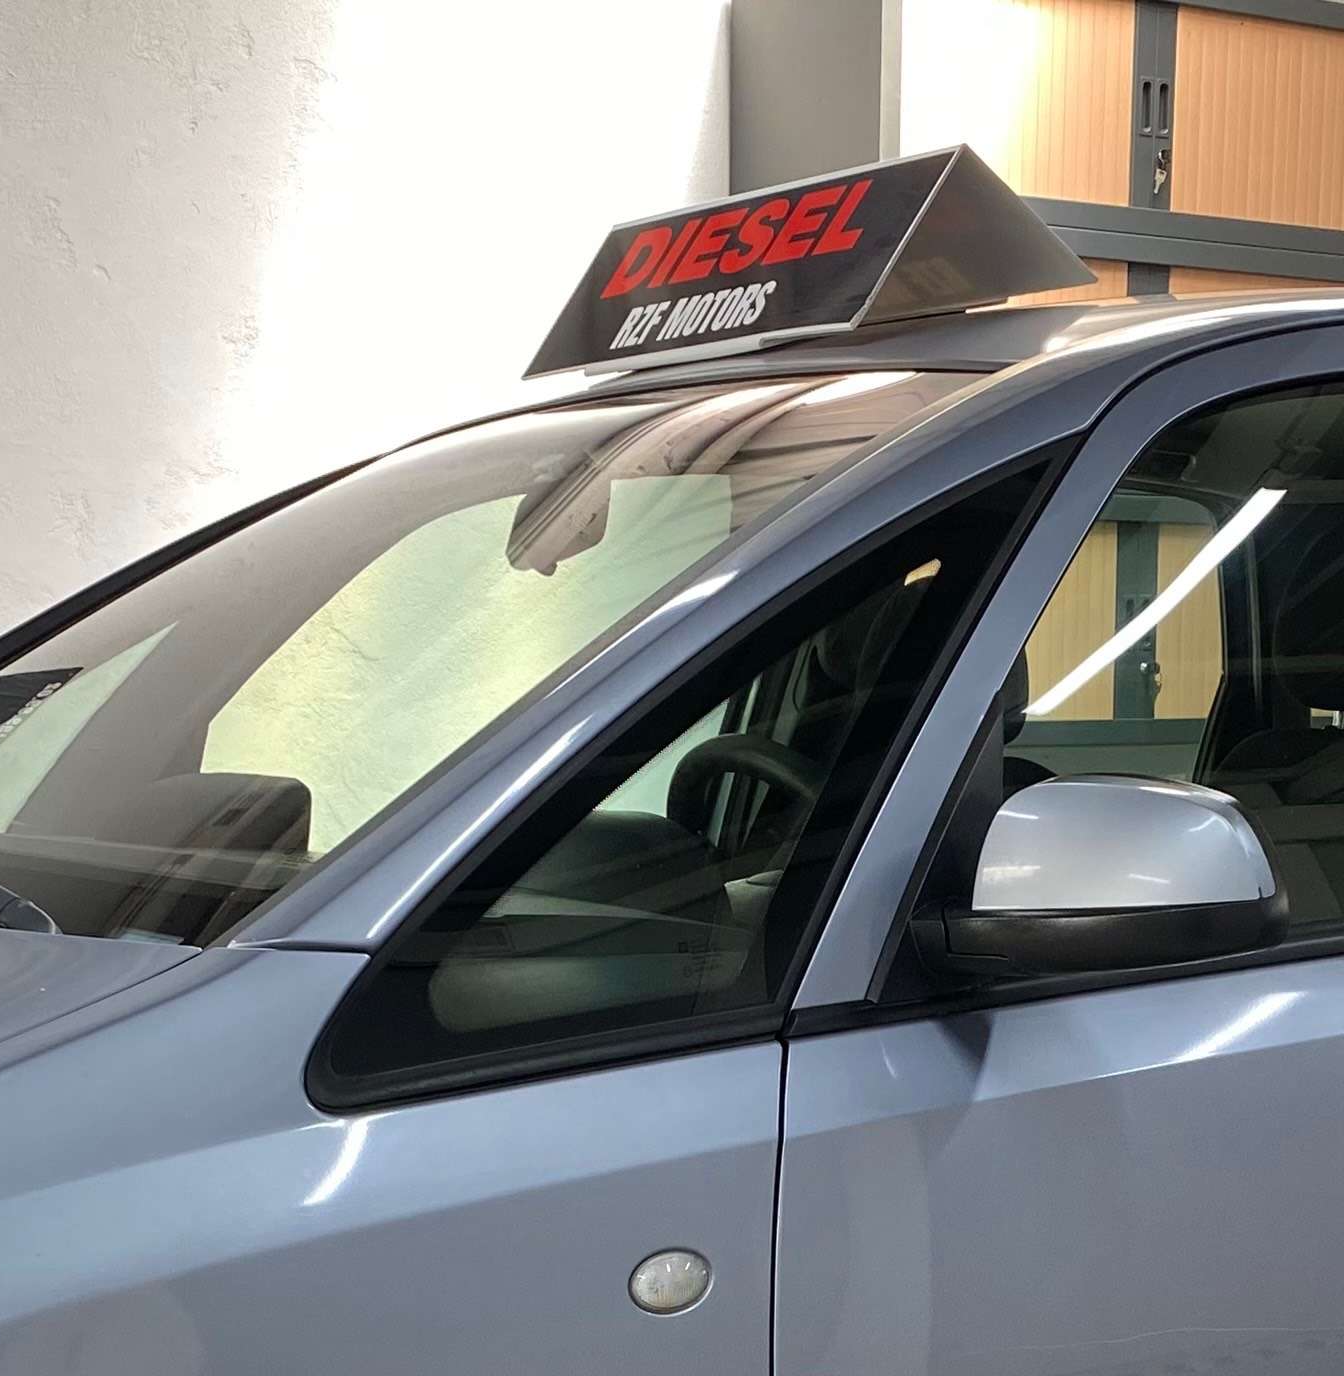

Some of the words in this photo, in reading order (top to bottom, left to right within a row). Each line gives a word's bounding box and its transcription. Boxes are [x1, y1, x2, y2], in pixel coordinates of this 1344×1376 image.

[600, 179, 873, 300] DIESEL
[609, 301, 674, 350] RZF
[656, 280, 777, 341] MOTORS
